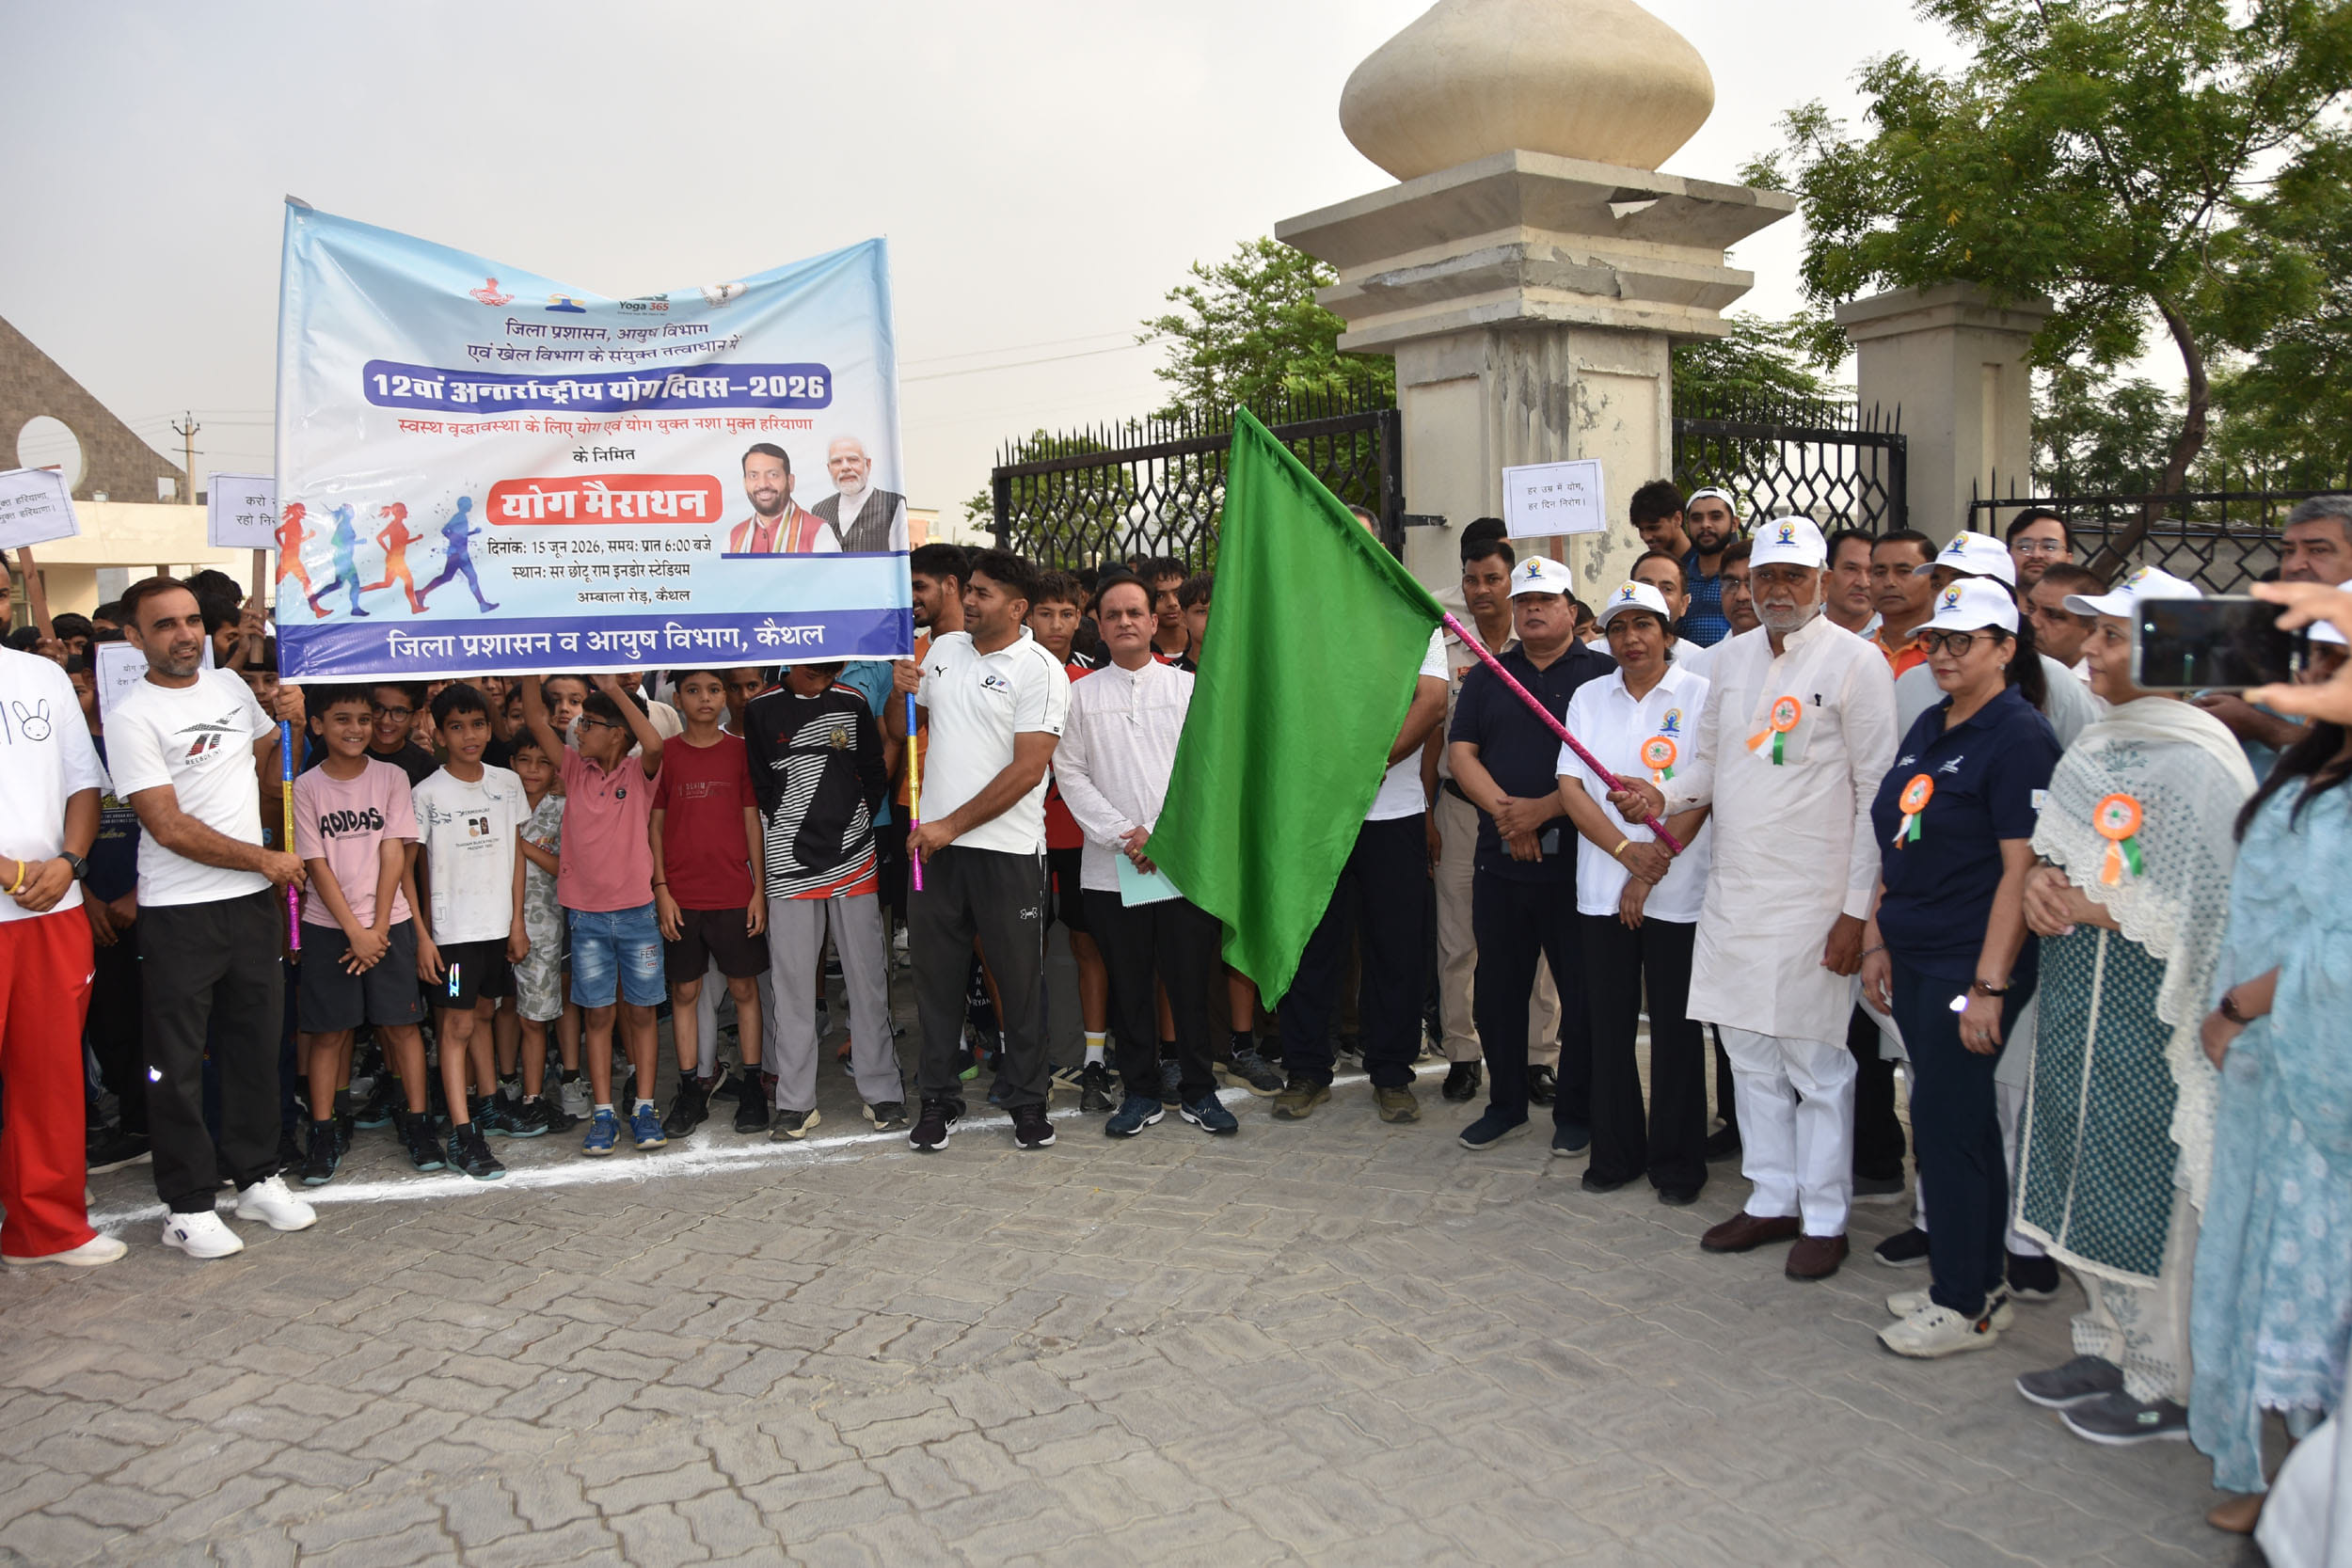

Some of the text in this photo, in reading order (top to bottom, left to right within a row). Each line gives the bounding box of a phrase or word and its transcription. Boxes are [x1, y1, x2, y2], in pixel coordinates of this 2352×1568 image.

[619, 300, 669, 311] Yoga 365
[505, 317, 708, 343] जिला प्रशासन, आयुष विभाग
[467, 341, 492, 363] एवं
[496, 342, 531, 362] खेल
[535, 345, 584, 362] विभाग
[588, 344, 605, 363] के
[609, 345, 659, 365] संयुक्त
[727, 335, 742, 351] में
[373, 373, 445, 400] 12वां
[449, 379, 603, 404] अन्तर्राष्ट्रीय
[607, 376, 662, 402] योग
[524, 415, 539, 434] के
[543, 416, 574, 438] लिए
[577, 417, 601, 435] योग
[603, 415, 625, 436] एवं
[626, 414, 652, 432] योग
[656, 418, 689, 436] युक्त
[692, 417, 722, 430] नशा
[725, 417, 755, 436] मुक्त
[758, 414, 814, 432] हरियाणा
[573, 445, 636, 464] के निमित
[246, 494, 266, 507] करो
[501, 481, 708, 519] योग मैराथन
[1527, 486, 1537, 495] हर
[1528, 502, 1538, 511] हर
[1541, 499, 1556, 509] दिन
[235, 513, 254, 526] रहो
[532, 541, 546, 554] 15
[548, 540, 567, 559] जून
[571, 540, 604, 555] 2026,
[641, 538, 661, 553] प्रात
[664, 539, 691, 552] 6:00
[692, 533, 712, 552] बजे
[549, 565, 565, 579] सर
[568, 560, 591, 583] छोटू
[591, 563, 611, 578] राम
[612, 559, 646, 579] इनडोर
[647, 558, 691, 578] स्टेडियम
[577, 586, 691, 605] अम्बाला रोड़, कैथल
[387, 617, 826, 660] जिला प्रशासन व आयुष विभाग, कैथल
[320, 807, 384, 839] ADIDAS
